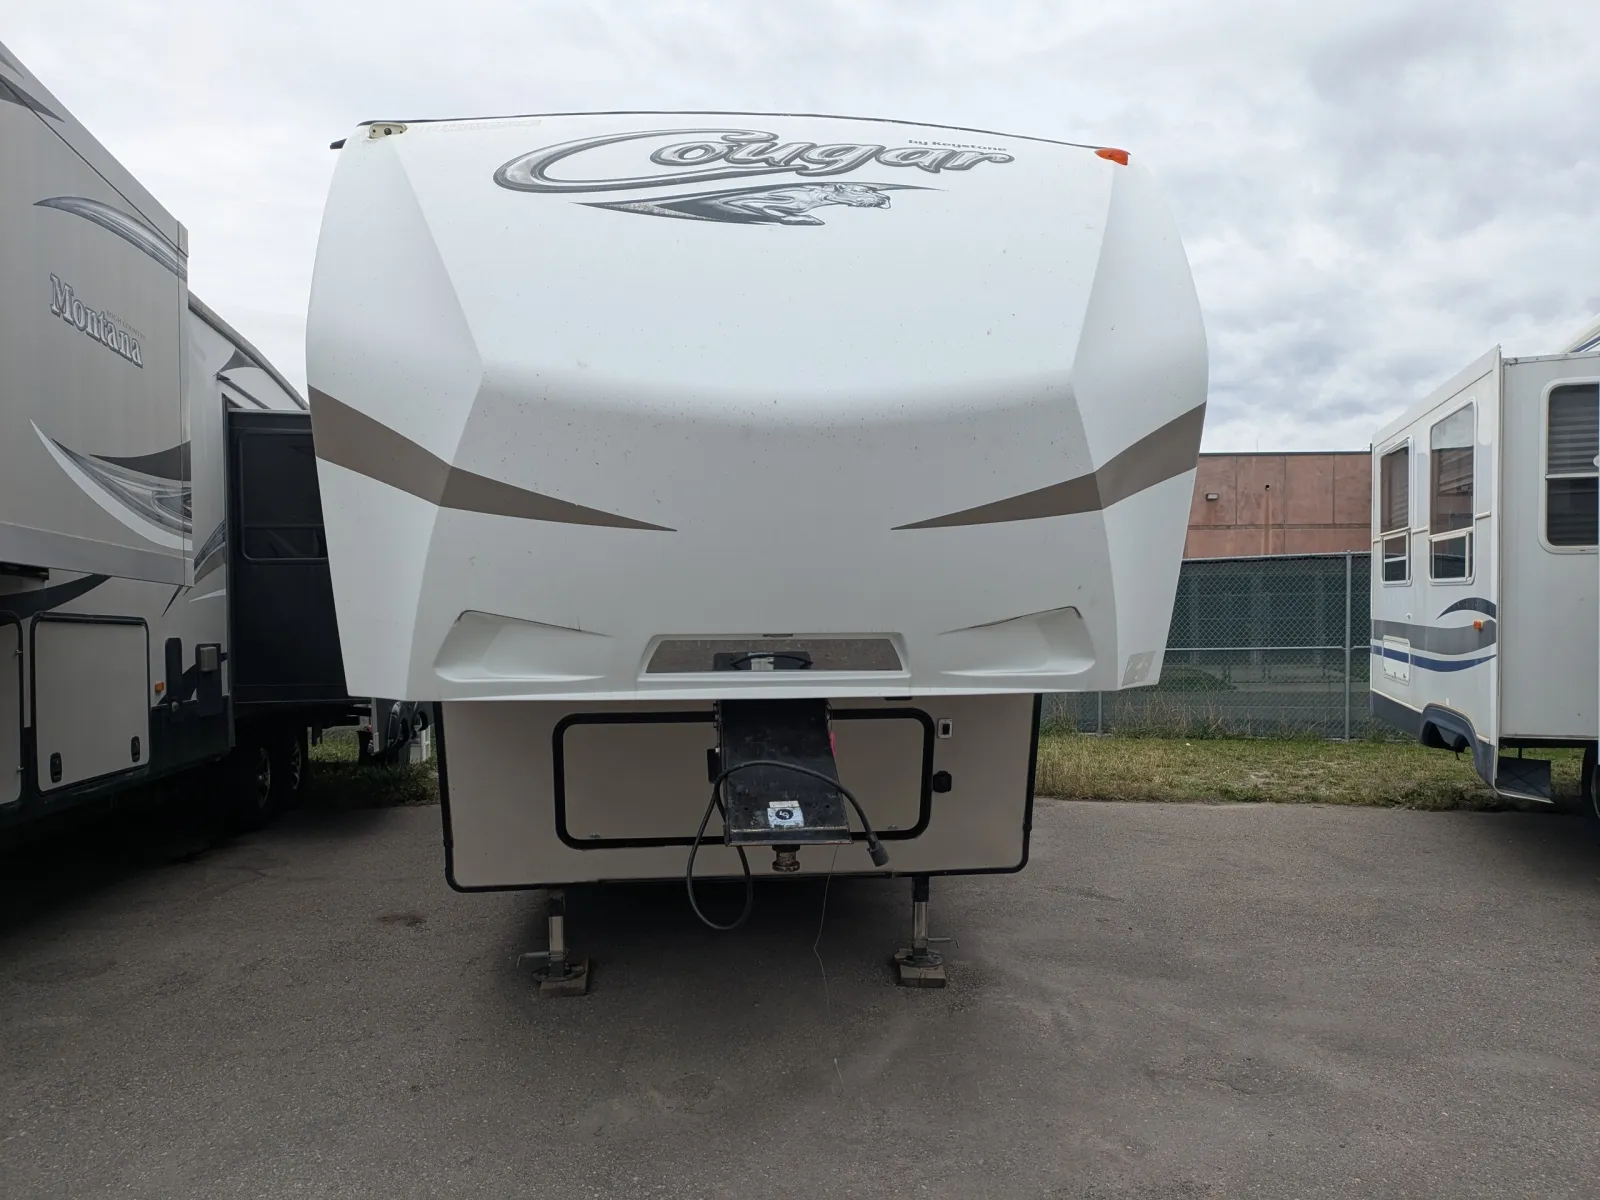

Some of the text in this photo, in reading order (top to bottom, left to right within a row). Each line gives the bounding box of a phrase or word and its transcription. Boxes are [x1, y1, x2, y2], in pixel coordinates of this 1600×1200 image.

[493, 128, 1015, 193] Cougar
[932, 141, 1007, 151] Keystone
[49, 272, 144, 369] Montana
